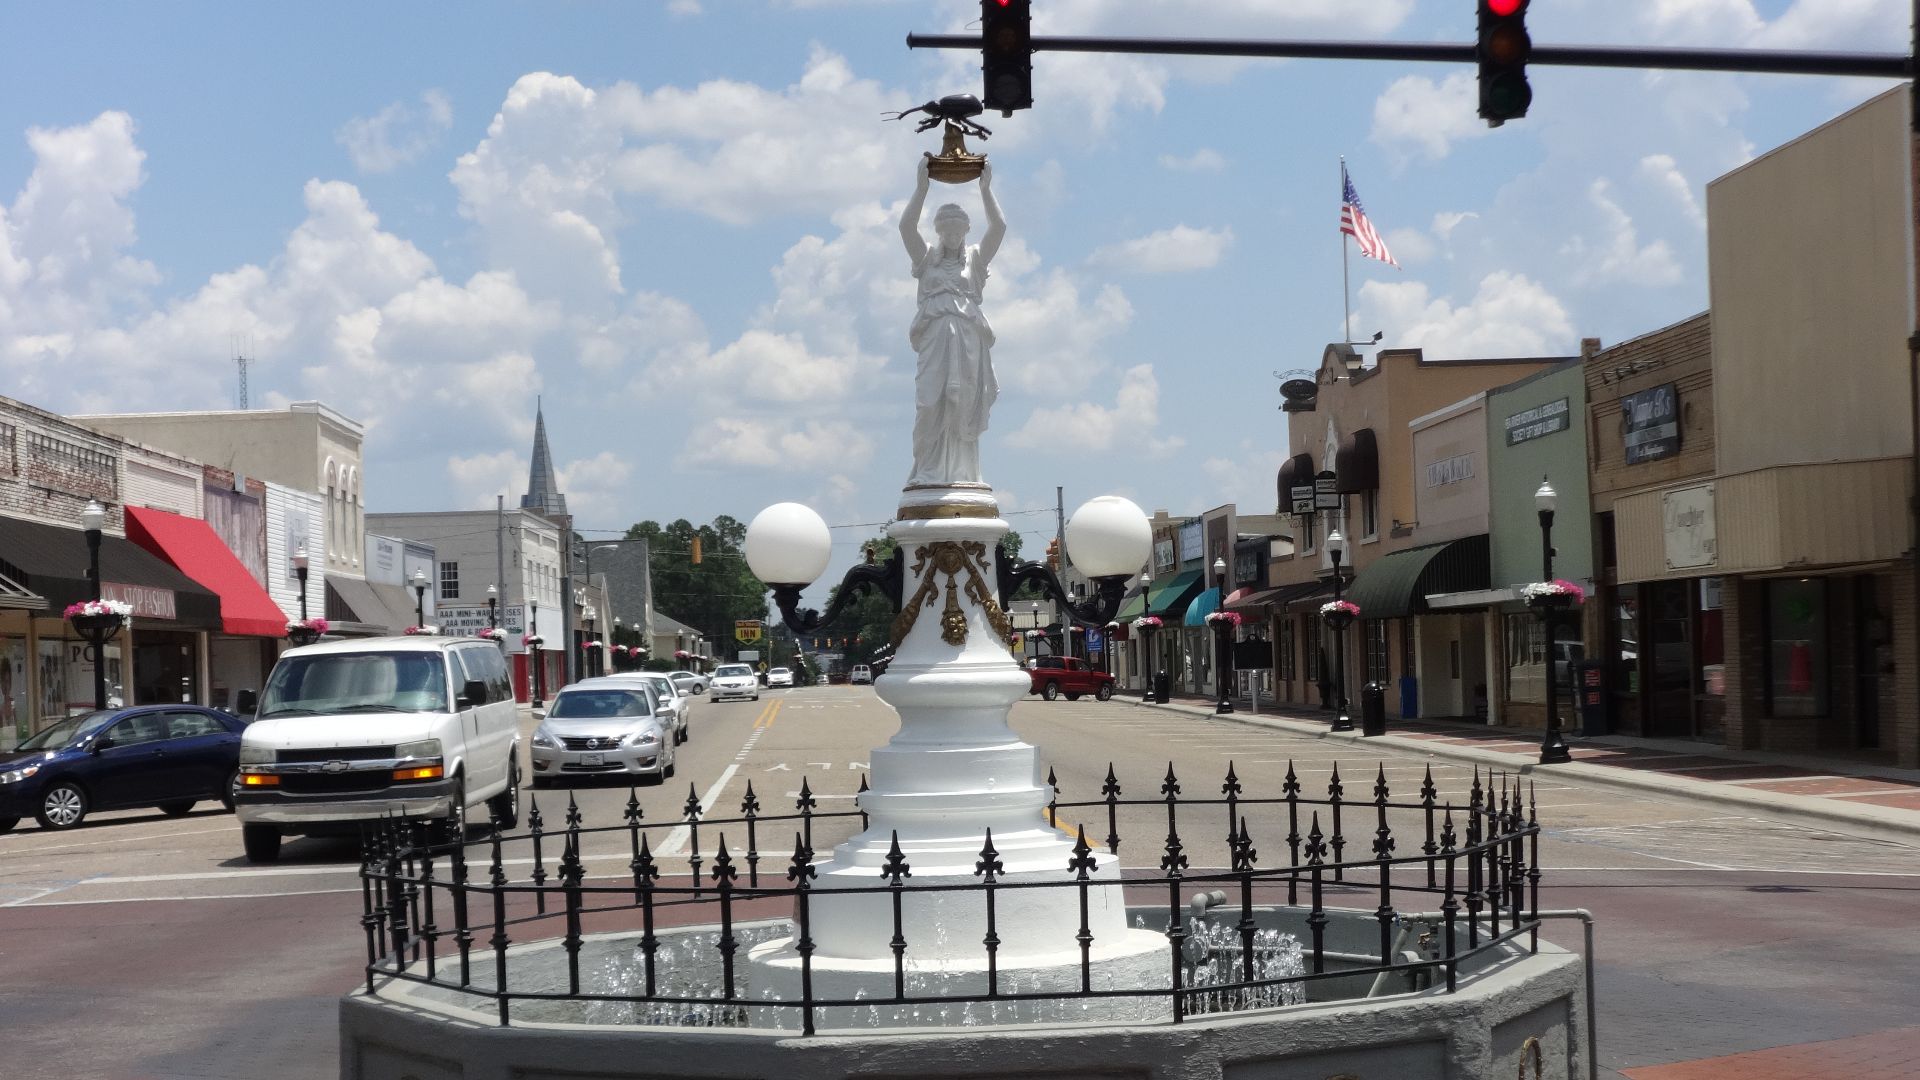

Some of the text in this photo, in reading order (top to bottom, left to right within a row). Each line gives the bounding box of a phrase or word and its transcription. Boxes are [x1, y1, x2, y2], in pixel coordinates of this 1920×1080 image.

[144, 590, 175, 617] FASHION
[461, 619, 485, 627] MOVING
[740, 629, 756, 638] INN
